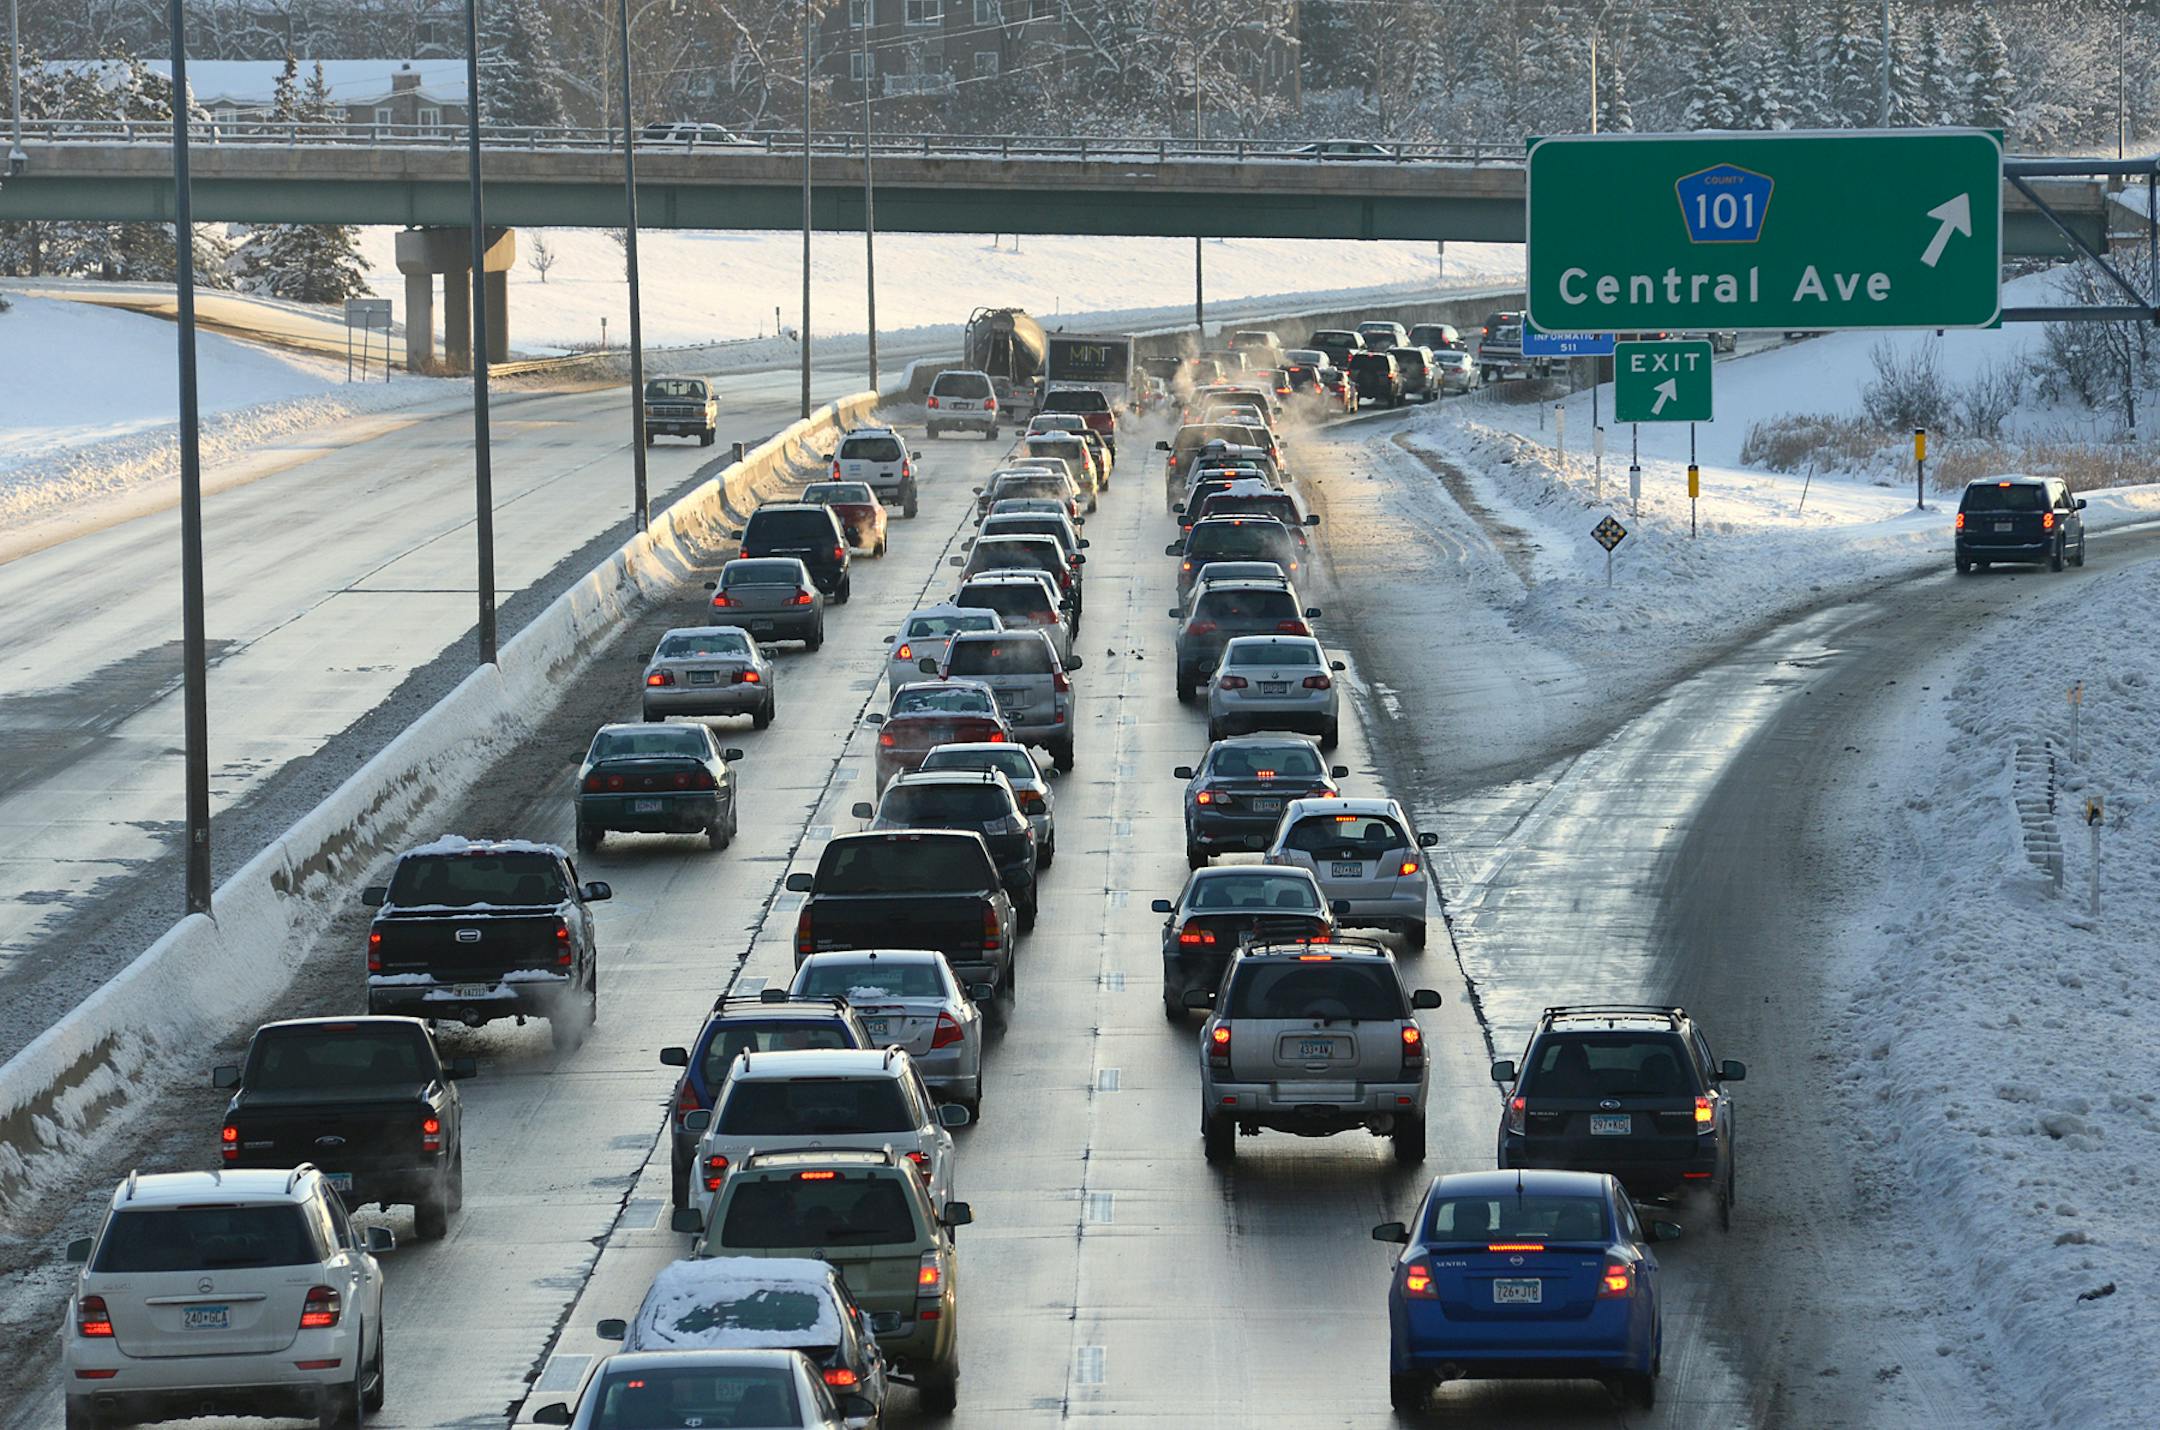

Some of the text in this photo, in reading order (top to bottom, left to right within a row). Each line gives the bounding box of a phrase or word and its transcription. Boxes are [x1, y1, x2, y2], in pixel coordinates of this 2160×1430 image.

[1704, 175, 1745, 186] COUNTY
[1695, 192, 1754, 230] 101
[1558, 264, 1893, 306] Central Ave
[1070, 345, 1112, 362] MINT
[1559, 343, 1577, 352] 511
[1630, 352, 1701, 373] EXIT
[184, 1311, 202, 1324] 240
